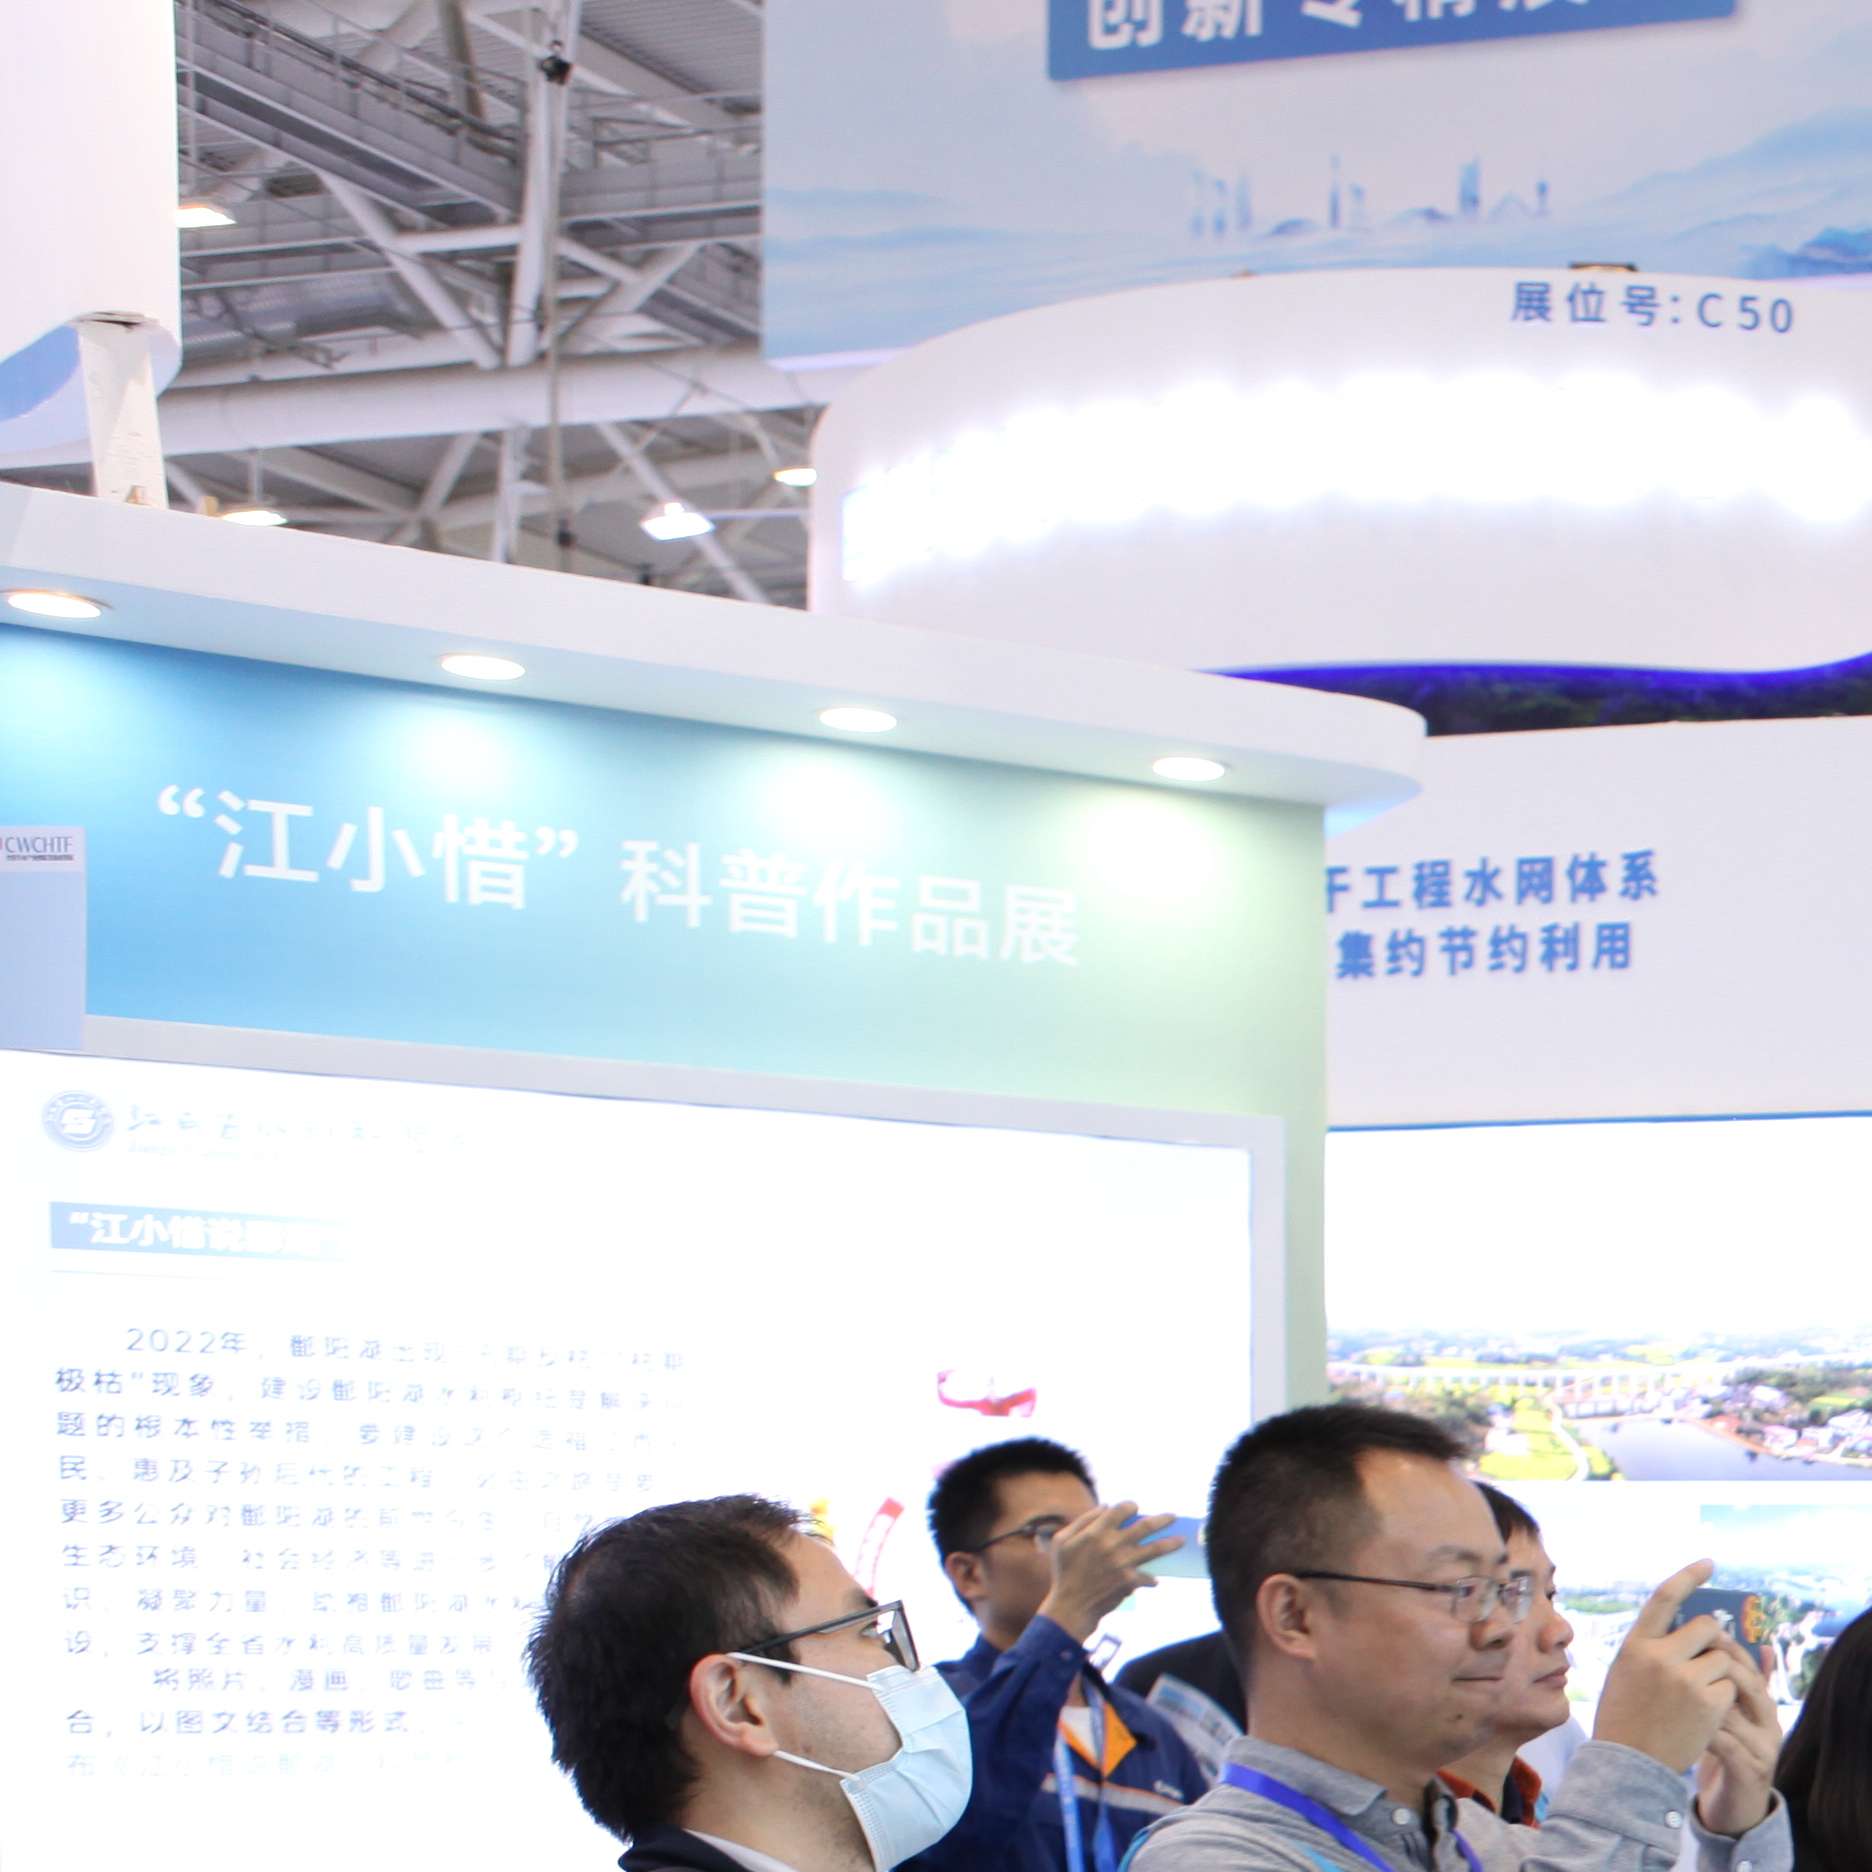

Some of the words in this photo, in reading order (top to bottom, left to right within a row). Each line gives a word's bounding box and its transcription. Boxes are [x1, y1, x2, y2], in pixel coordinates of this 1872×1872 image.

[1335, 922, 1634, 980] 集约节约利用
